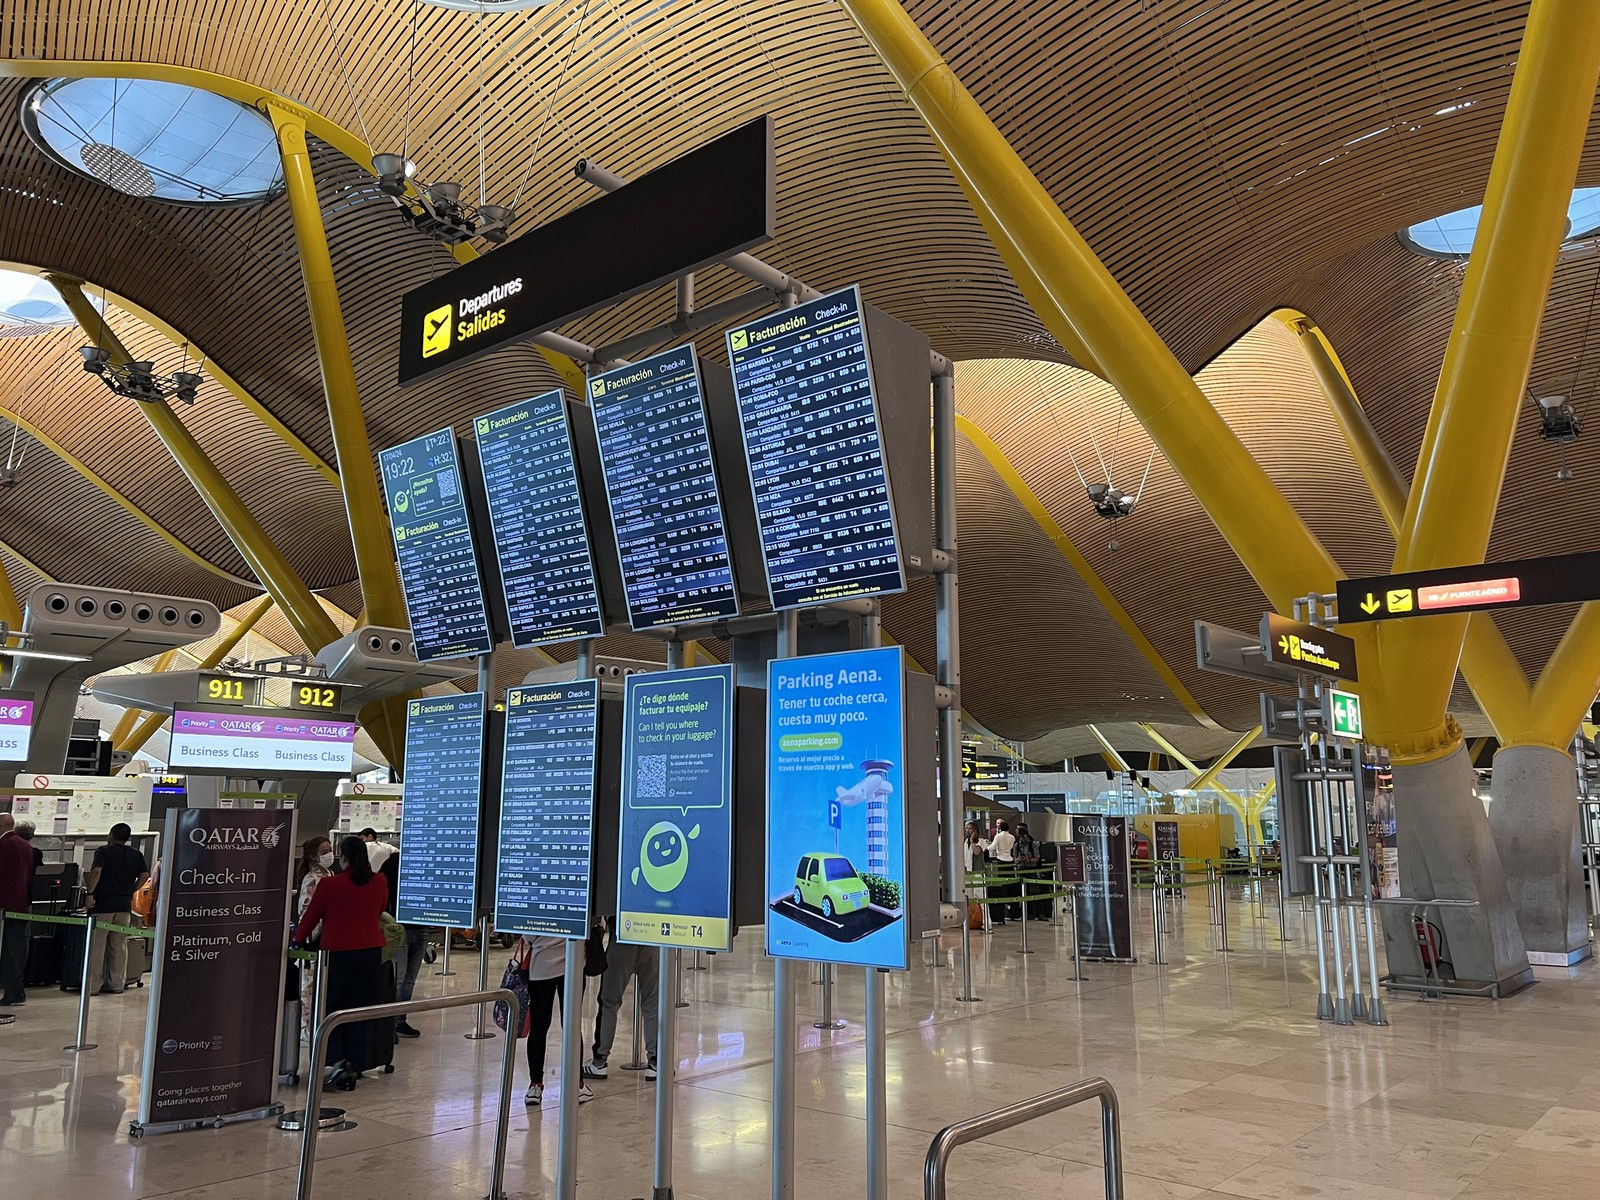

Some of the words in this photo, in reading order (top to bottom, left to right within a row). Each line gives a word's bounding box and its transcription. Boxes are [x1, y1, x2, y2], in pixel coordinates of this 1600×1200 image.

[459, 278, 522, 317] Departures
[457, 309, 506, 341] Salidas
[750, 315, 806, 343] Facturación
[815, 302, 848, 320] Check-in
[607, 368, 653, 391] Facturación
[660, 359, 686, 373] Check-in
[490, 411, 528, 429] Facturación
[534, 403, 556, 415] Check-in
[385, 457, 415, 480] 19:22
[406, 522, 439, 537] Facturación
[443, 517, 462, 526] Check-in
[1450, 590, 1480, 598] PUENTE
[778, 672, 834, 690] Parking
[838, 669, 881, 684] Aena.
[209, 679, 243, 699] 911
[300, 687, 334, 707] 912
[522, 691, 561, 703] Facturación
[568, 690, 590, 698] Check-in
[640, 696, 650, 706] ¿Te
[652, 694, 666, 704] digo
[668, 692, 689, 701] dónde
[779, 698, 807, 709] Tener
[810, 697, 820, 707] tu
[824, 694, 853, 706] coche
[856, 693, 887, 704] cerca,
[421, 703, 454, 713] Facturación
[639, 706, 665, 715] facturar
[675, 702, 708, 713] equipaje?
[221, 720, 251, 730] QATAR
[779, 714, 811, 726] cuesta
[814, 713, 836, 725] muy
[840, 711, 868, 725] poco.
[310, 726, 337, 734] QATAR
[639, 722, 649, 732] Can
[655, 721, 664, 730] tell
[666, 722, 677, 731] you
[679, 720, 698, 728] where
[638, 734, 645, 742] to
[646, 733, 663, 742] check
[672, 733, 686, 742] your
[687, 729, 716, 741] luggage?
[782, 736, 838, 747] aenaparking.com
[0, 740, 17, 748] ass
[181, 746, 229, 757] Business
[232, 748, 259, 758] Class
[275, 750, 318, 760] Business
[321, 752, 345, 762] Class
[823, 756, 840, 764] precio
[831, 804, 838, 824] P
[1078, 825, 1108, 834] QATAR
[189, 828, 258, 846] QATAR
[179, 868, 256, 884] Check-in
[176, 907, 229, 917] Business
[233, 904, 262, 915] Class
[172, 935, 231, 946] Platinum,
[236, 932, 262, 944] Gold
[691, 926, 703, 938] T4
[171, 951, 180, 961] &
[186, 950, 220, 961] Silver
[178, 1040, 210, 1050] Priority
[158, 1088, 182, 1097] Going
[185, 1086, 209, 1095] places
[212, 1081, 242, 1093] together
[157, 1093, 228, 1107] qatarairways.com
